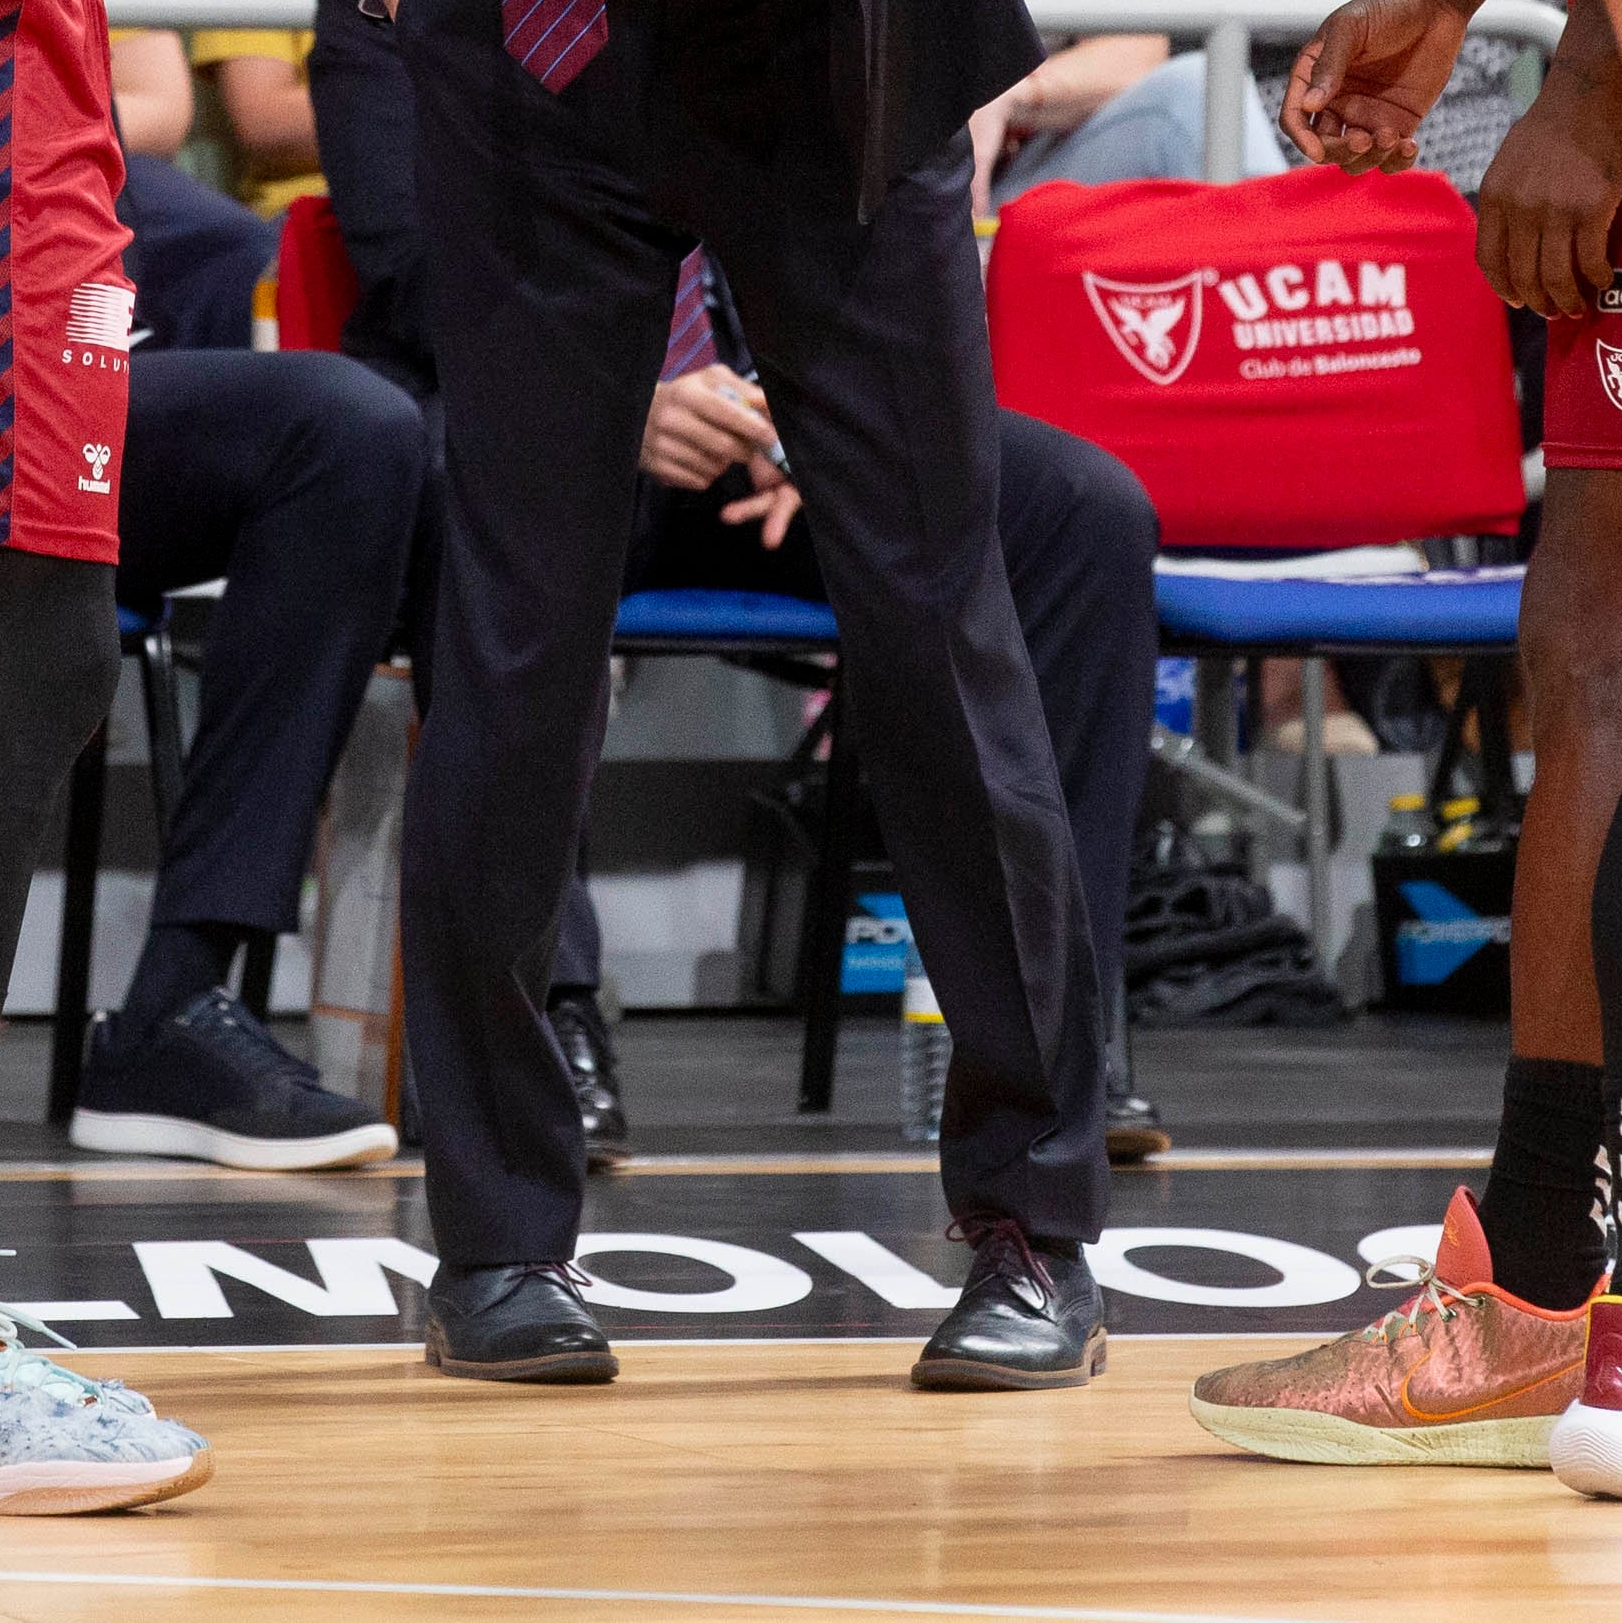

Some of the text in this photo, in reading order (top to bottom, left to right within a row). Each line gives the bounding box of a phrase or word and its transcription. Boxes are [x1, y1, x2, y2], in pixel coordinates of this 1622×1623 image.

[1219, 260, 1407, 321] UCAM
[1233, 307, 1415, 350] UNIVERSIDAD
[77, 475, 110, 495] hummel
